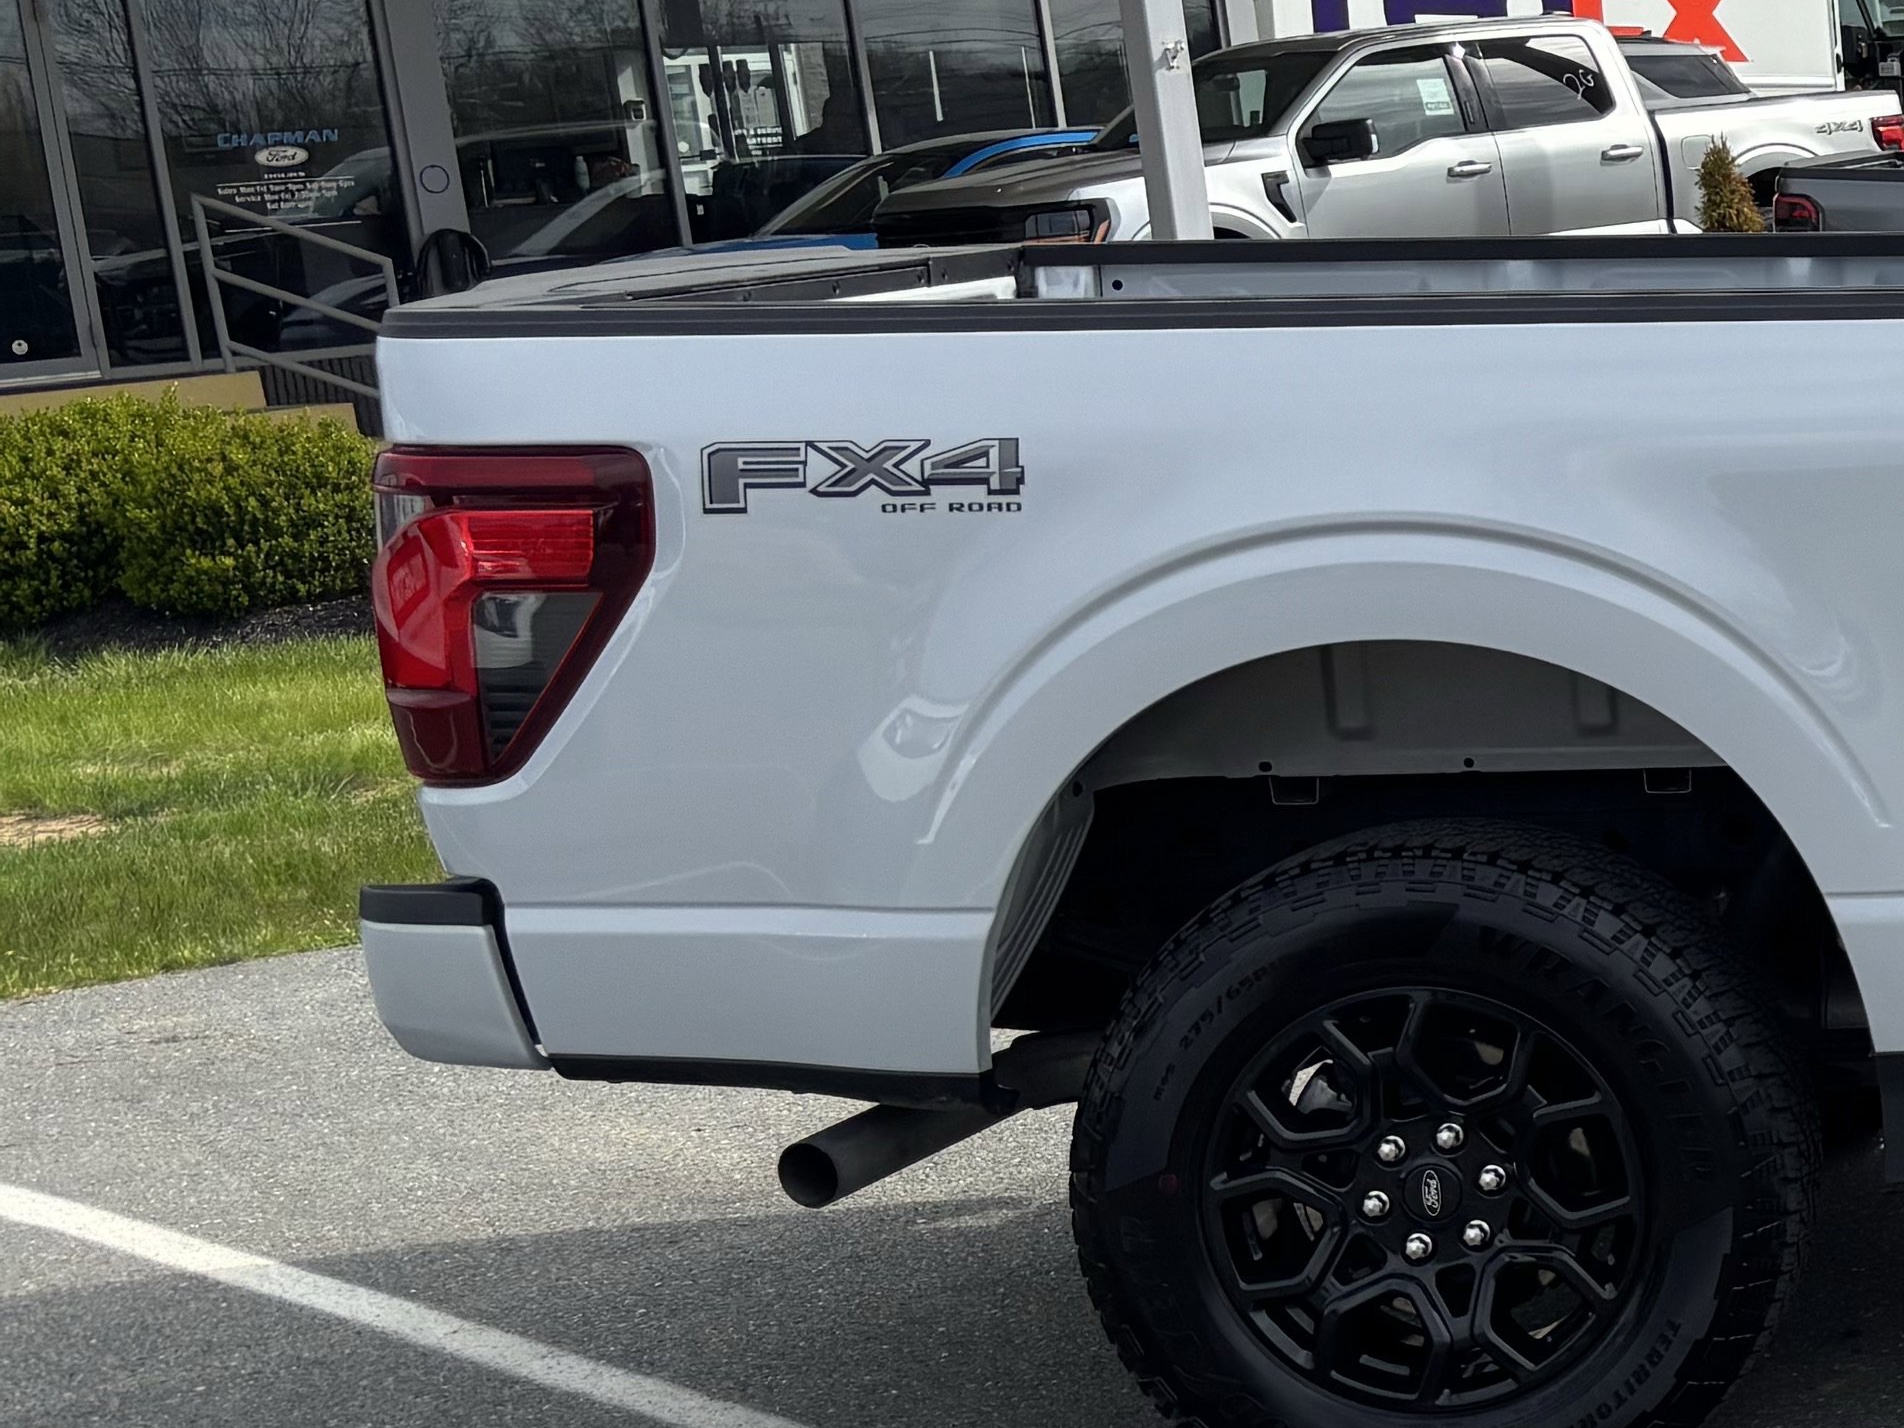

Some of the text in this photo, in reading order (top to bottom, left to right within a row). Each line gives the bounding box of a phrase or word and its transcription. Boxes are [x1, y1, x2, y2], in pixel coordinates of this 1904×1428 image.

[217, 129, 338, 147] CHAPMAN
[266, 149, 298, 163] Ford
[700, 436, 1026, 515] FX4
[880, 500, 1023, 514] OFF ROAD
[1179, 958, 1283, 1051] 275/65R
